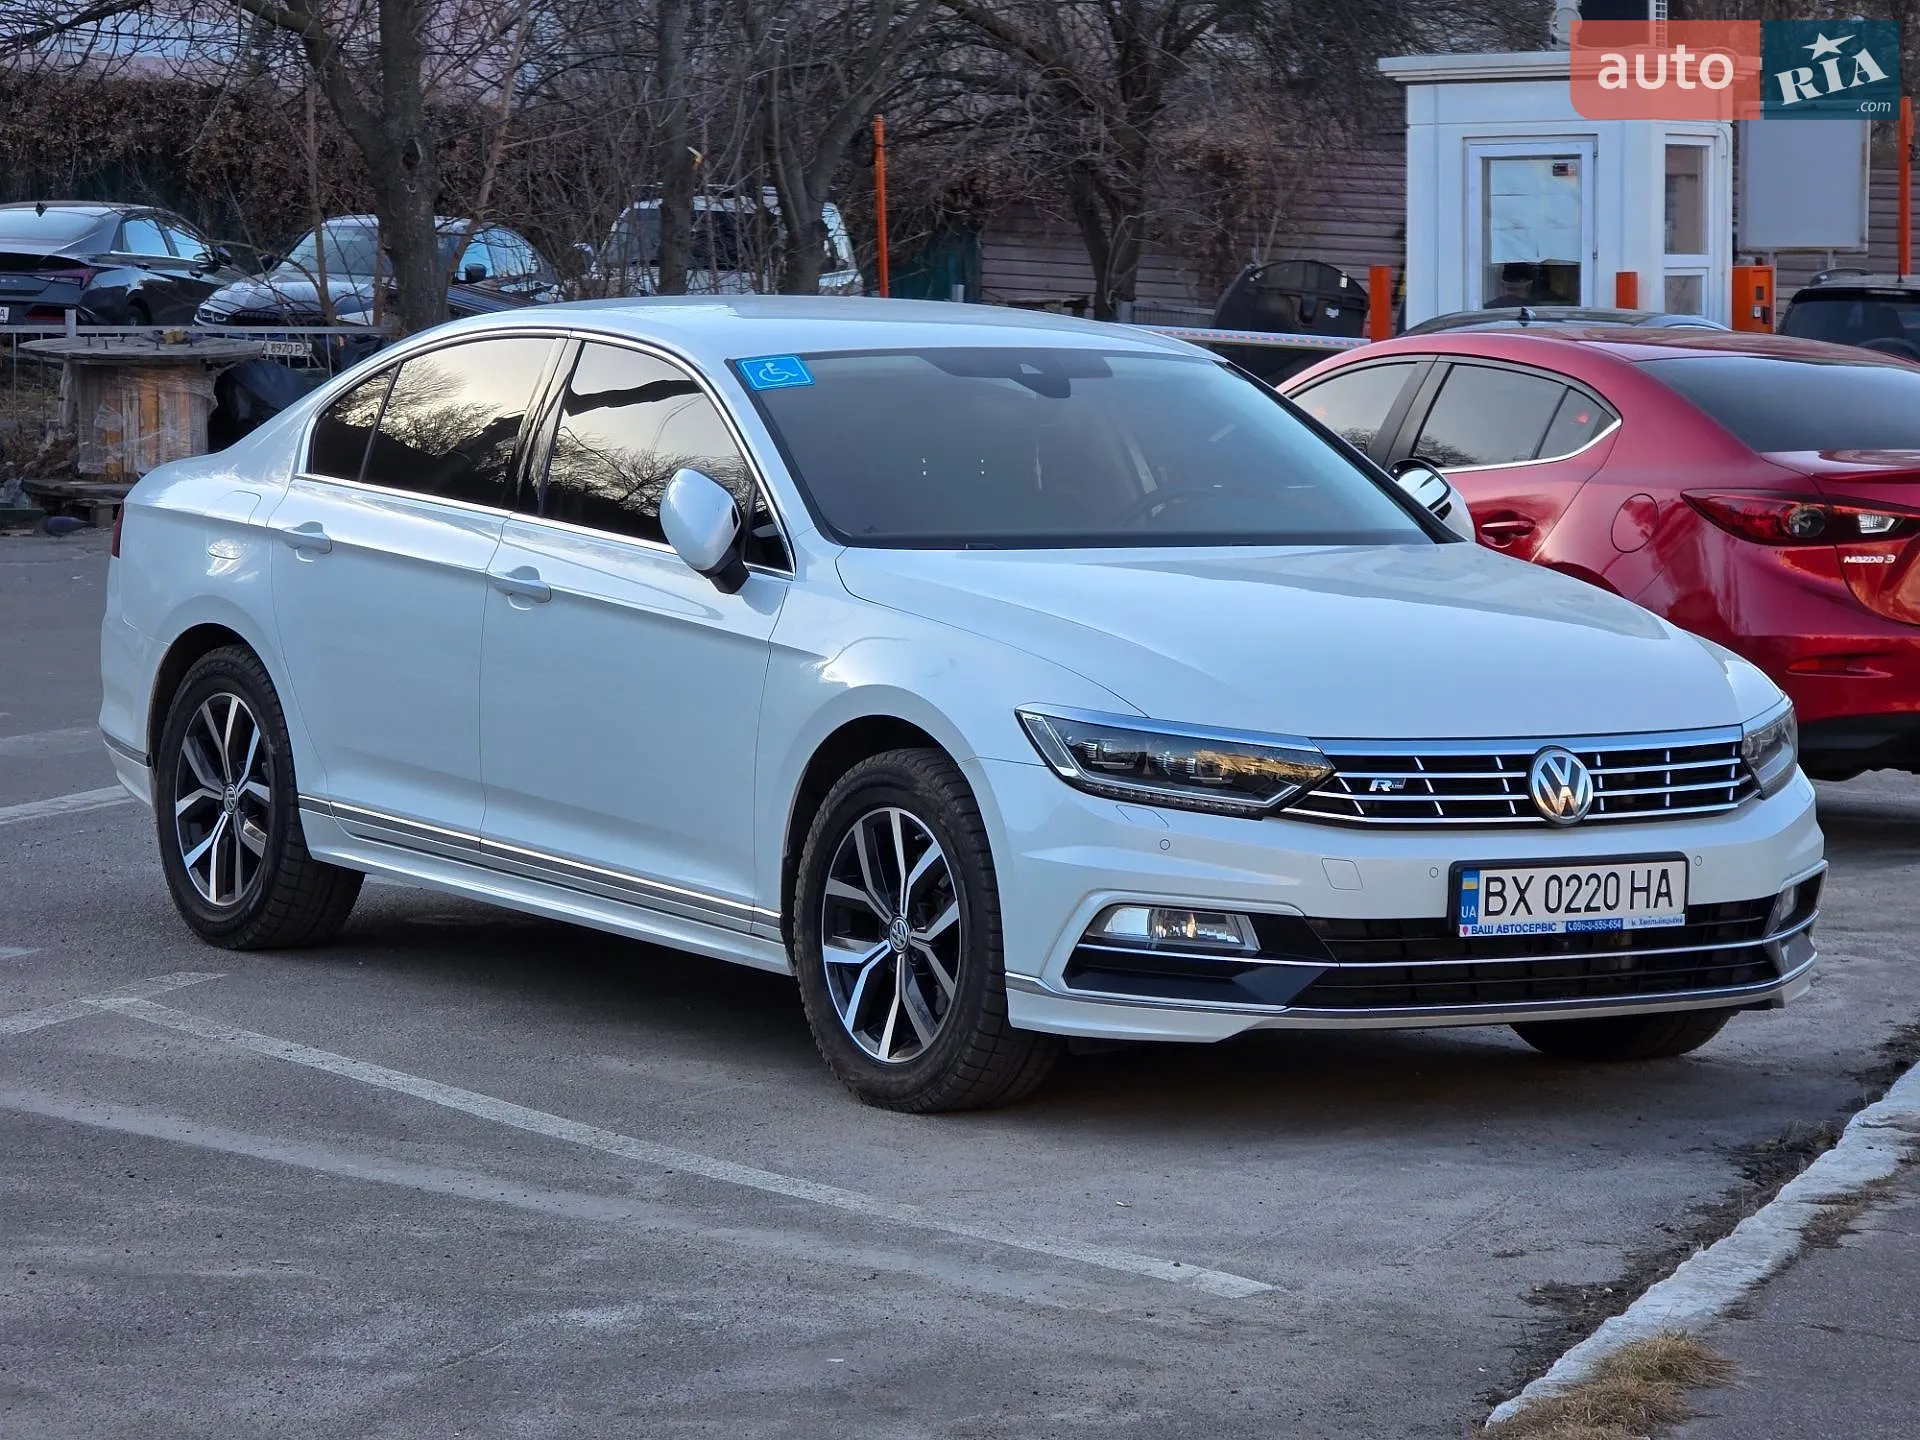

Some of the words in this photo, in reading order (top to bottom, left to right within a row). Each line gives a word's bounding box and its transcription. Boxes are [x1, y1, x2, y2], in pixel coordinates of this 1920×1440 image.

[1484, 875, 1534, 916] BX
[1544, 871, 1621, 914] 0220
[1629, 868, 1673, 910] HA
[1461, 906, 1477, 919] UA
[1471, 925, 1494, 935] ВАШ
[1496, 922, 1557, 934] АВТОСЕРВІС
